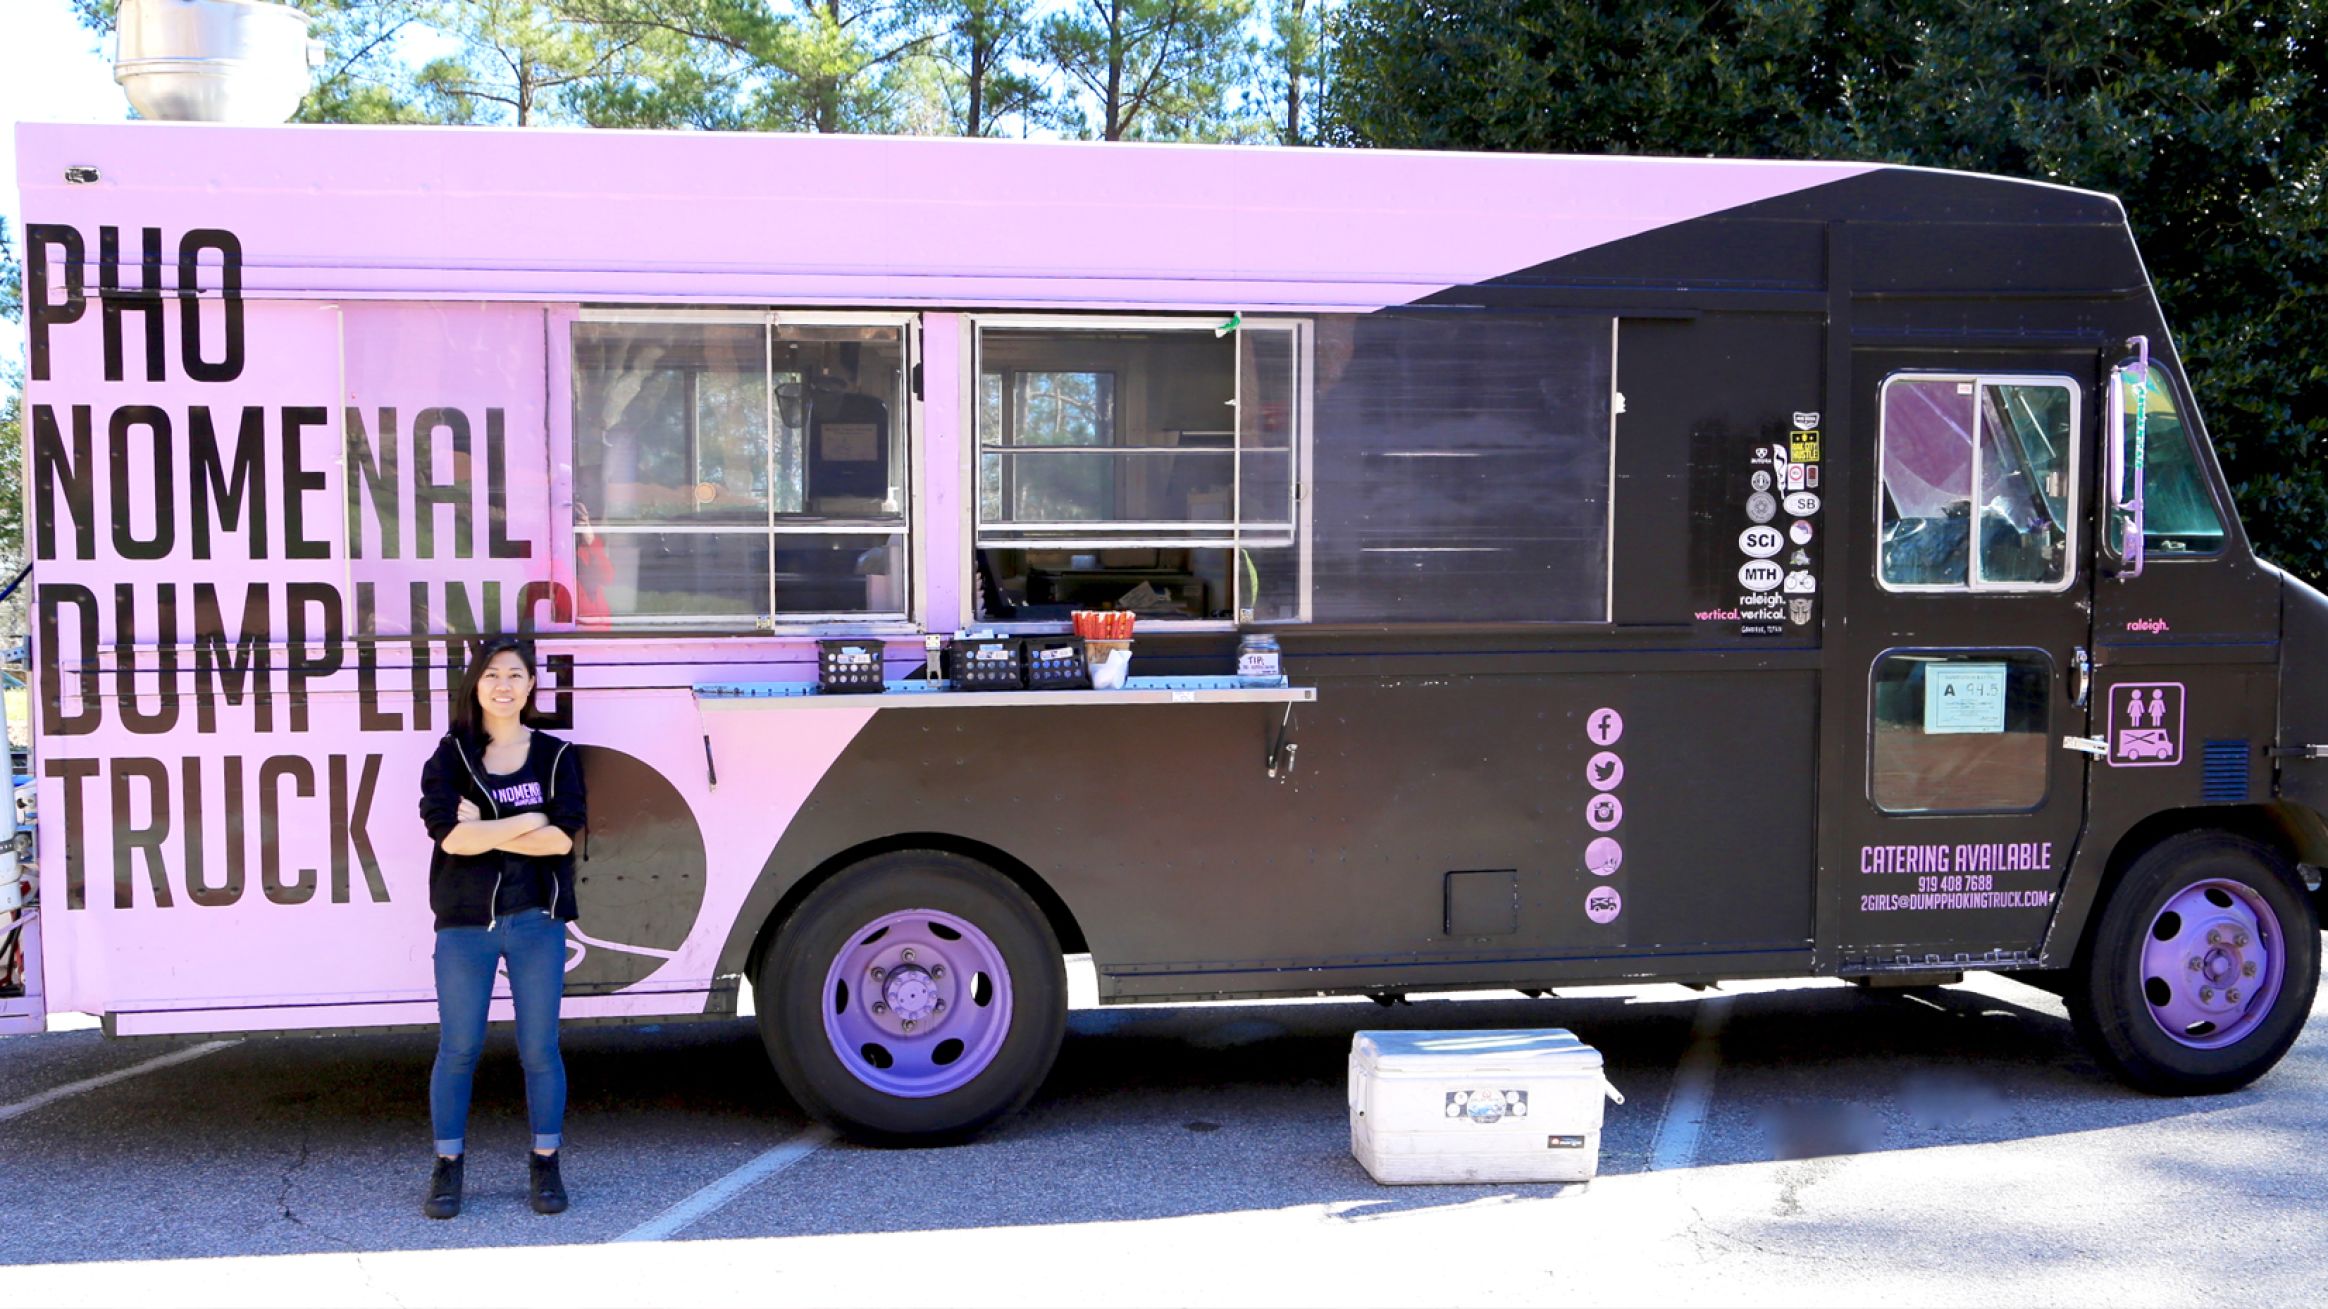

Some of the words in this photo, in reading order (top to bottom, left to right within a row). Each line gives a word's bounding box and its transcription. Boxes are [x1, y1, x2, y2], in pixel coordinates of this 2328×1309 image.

[27, 223, 245, 382] PHO
[36, 404, 532, 560] NOMENAL
[1746, 534, 1775, 548] SCI
[1745, 568, 1777, 580] MTH
[1943, 684, 1956, 697] A
[45, 753, 391, 910] TRUCK
[1861, 846, 1950, 874] CATERING
[1955, 842, 2051, 872] AVAILABLE
[1918, 876, 1937, 892] 919
[1940, 875, 1961, 891] 408
[1965, 874, 1993, 891] 7688
[1861, 891, 2048, 912] 2GIRLS@DUMPPHOKINGTRUCK.COM
